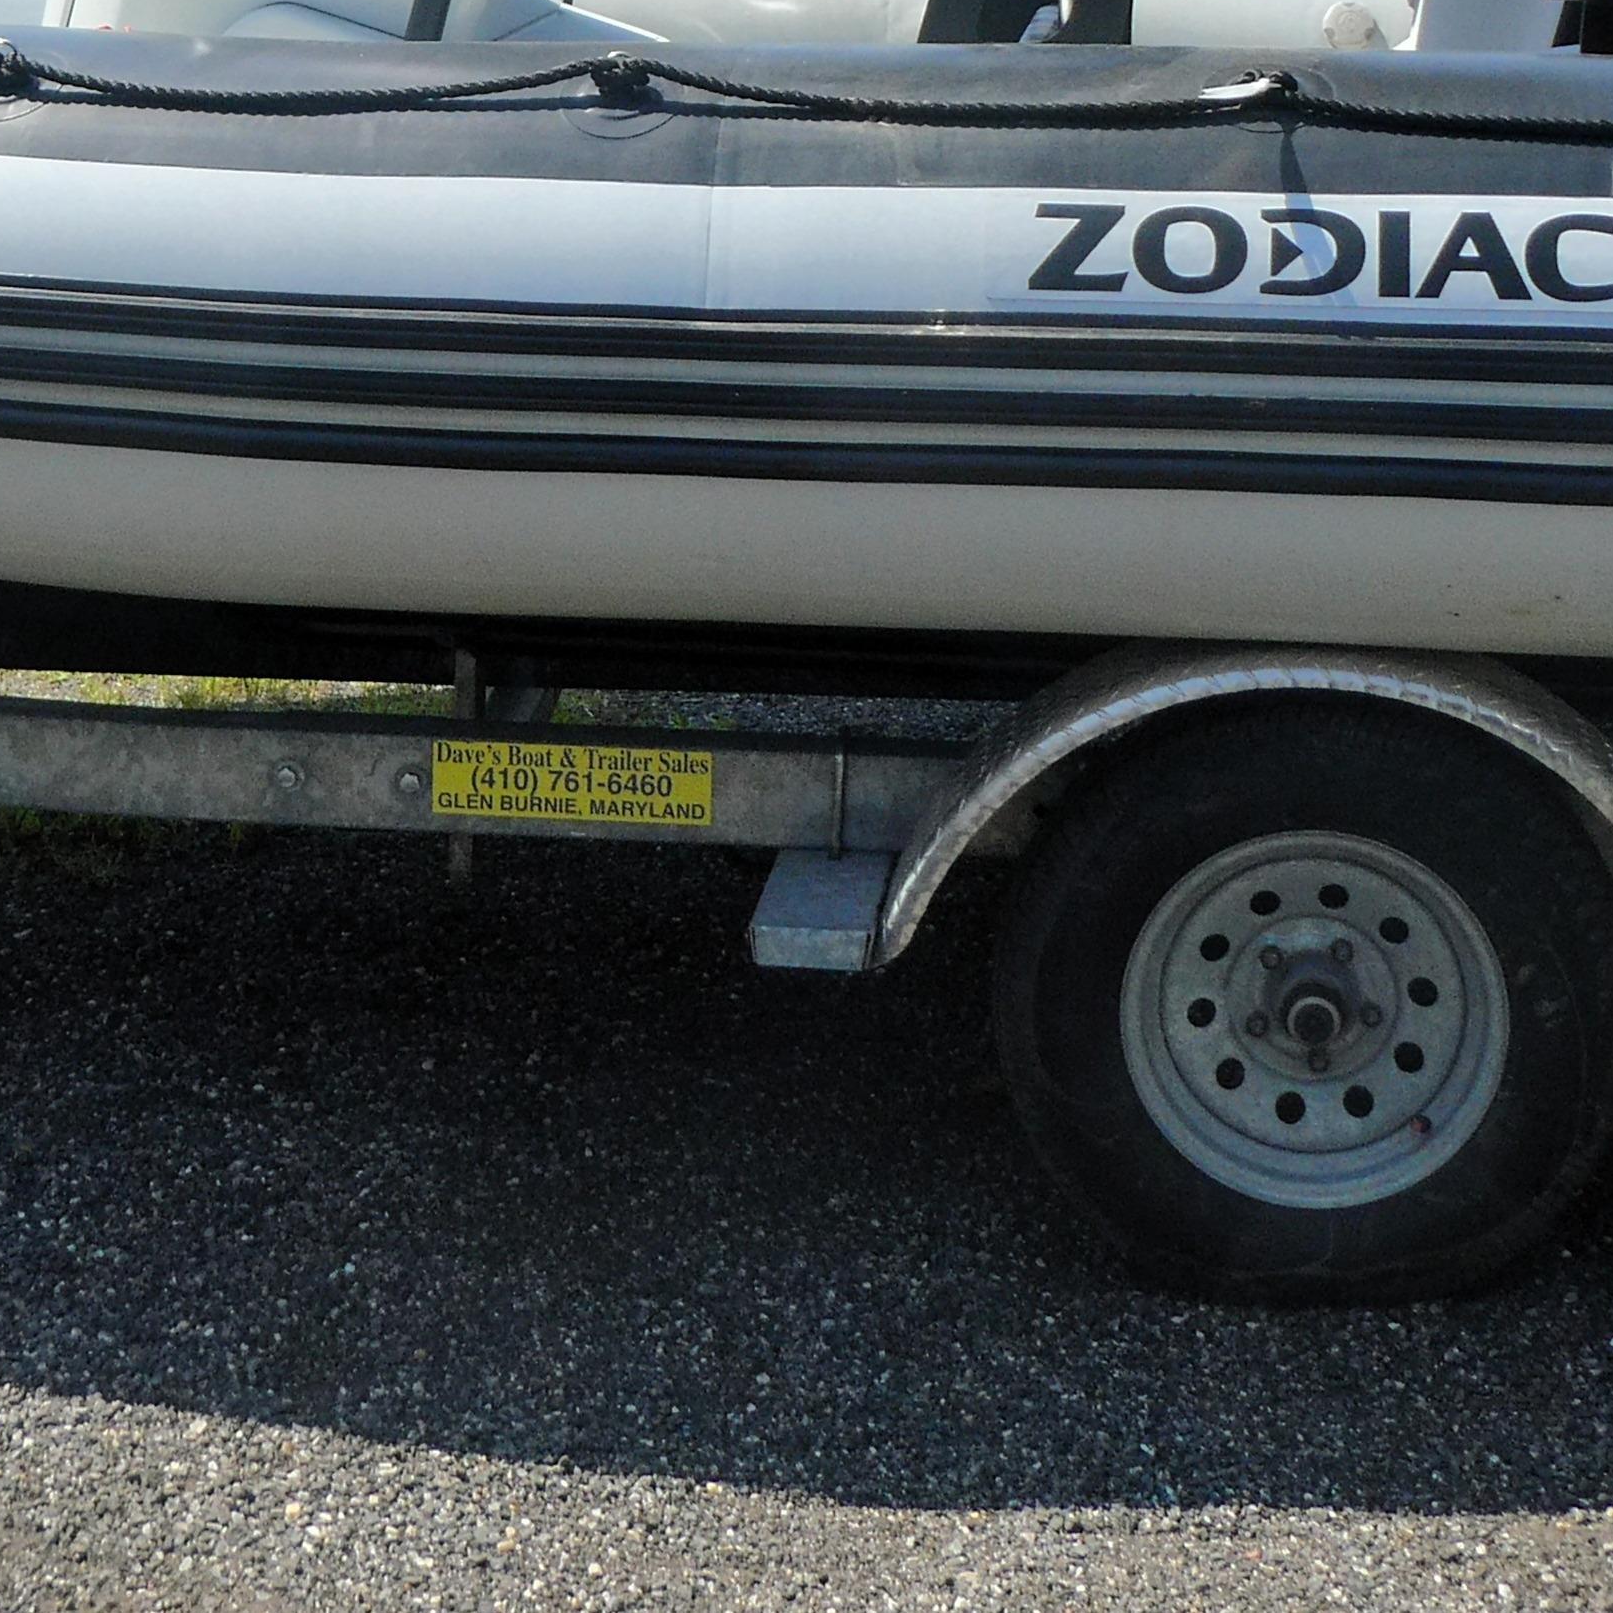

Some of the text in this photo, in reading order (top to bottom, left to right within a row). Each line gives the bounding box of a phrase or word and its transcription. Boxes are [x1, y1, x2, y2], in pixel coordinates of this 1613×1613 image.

[437, 741, 710, 776] Dave's Boat & Trailer Sales
[470, 765, 674, 798] (410) 761-6460
[438, 791, 706, 820] GLEN BURNIE, MARYLAND
